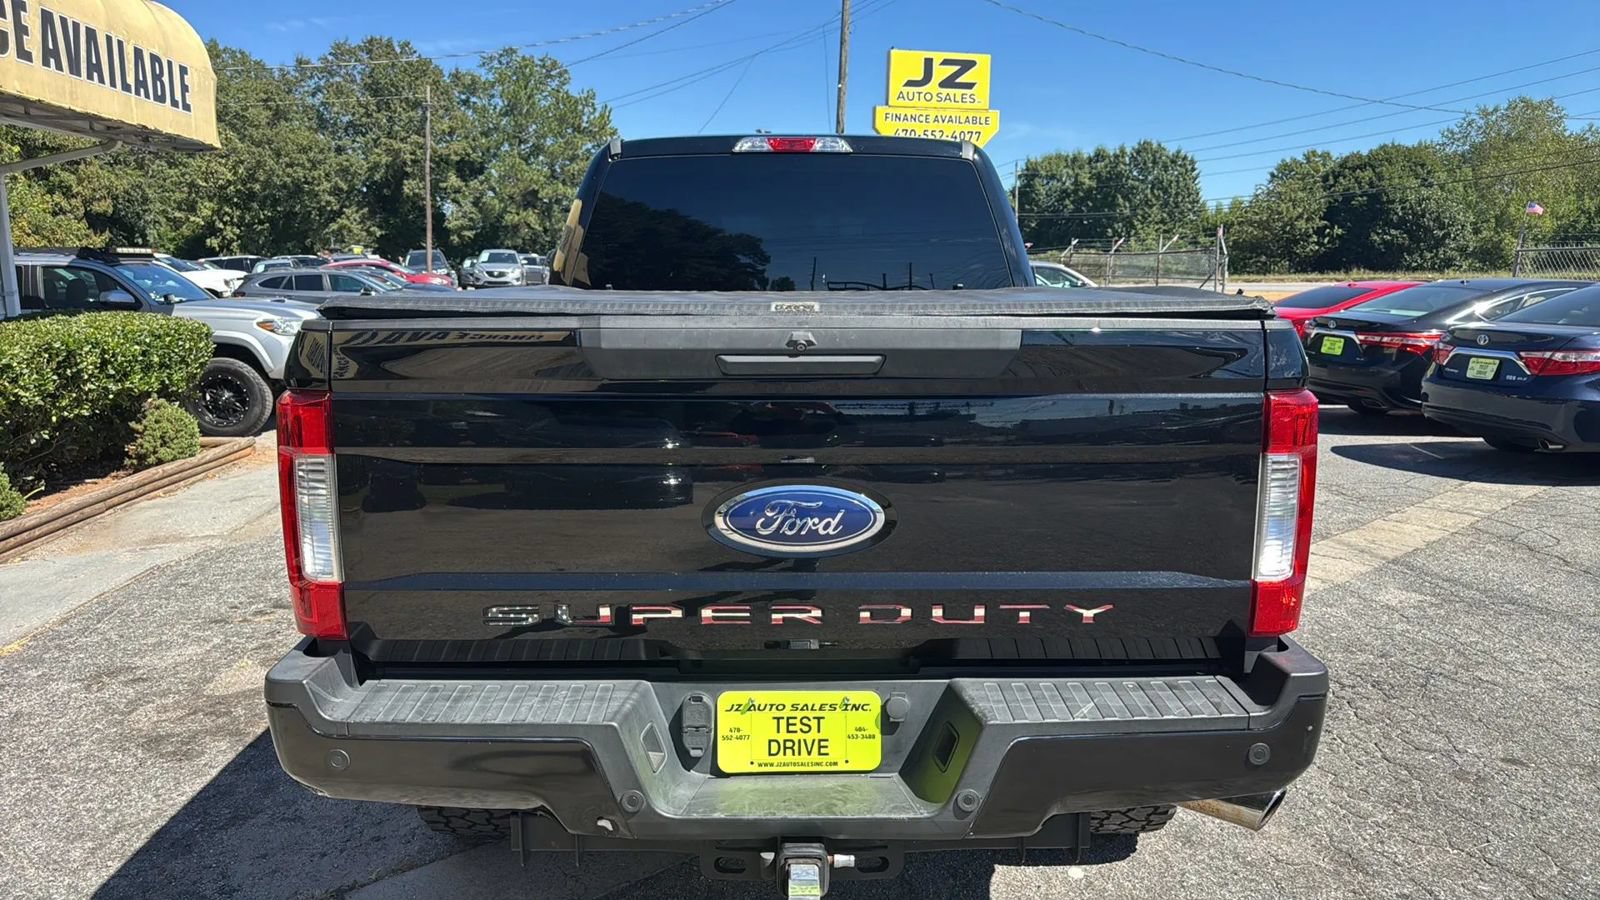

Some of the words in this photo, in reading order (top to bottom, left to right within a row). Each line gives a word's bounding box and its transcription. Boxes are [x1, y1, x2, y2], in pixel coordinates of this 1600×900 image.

[41, 8, 192, 112] AVAILABLE
[902, 57, 977, 90] JZ
[896, 90, 934, 102] AUTO
[936, 92, 976, 104] SALES
[884, 112, 931, 124] FINANCE
[933, 115, 990, 126] AVAILABLE
[755, 500, 845, 535] Ford
[484, 604, 822, 625] SUPER
[858, 604, 1113, 624] DUTY
[725, 703, 743, 712] JZ
[747, 703, 786, 712] AUTO
[790, 703, 838, 712] SALES
[772, 716, 825, 734] TEST
[768, 739, 829, 756] DRIVE
